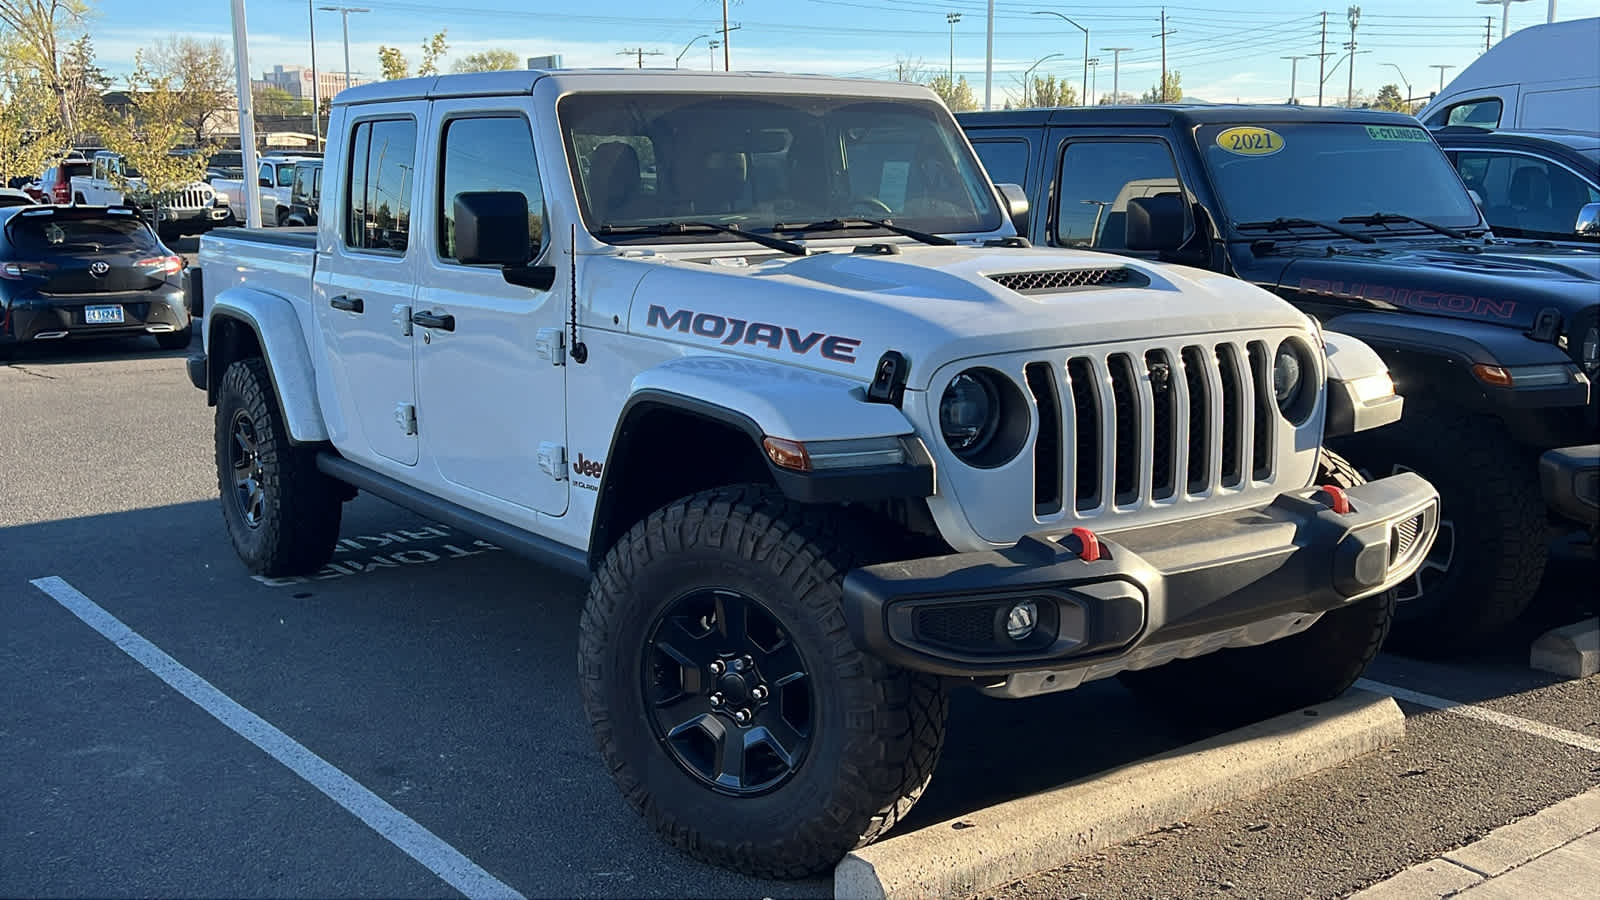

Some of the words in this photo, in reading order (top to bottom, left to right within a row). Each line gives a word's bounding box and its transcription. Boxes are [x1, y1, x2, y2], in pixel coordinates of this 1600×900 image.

[1230, 133, 1273, 150] 2021
[1299, 278, 1517, 318] RUBICON
[647, 304, 862, 364] MOJAVE
